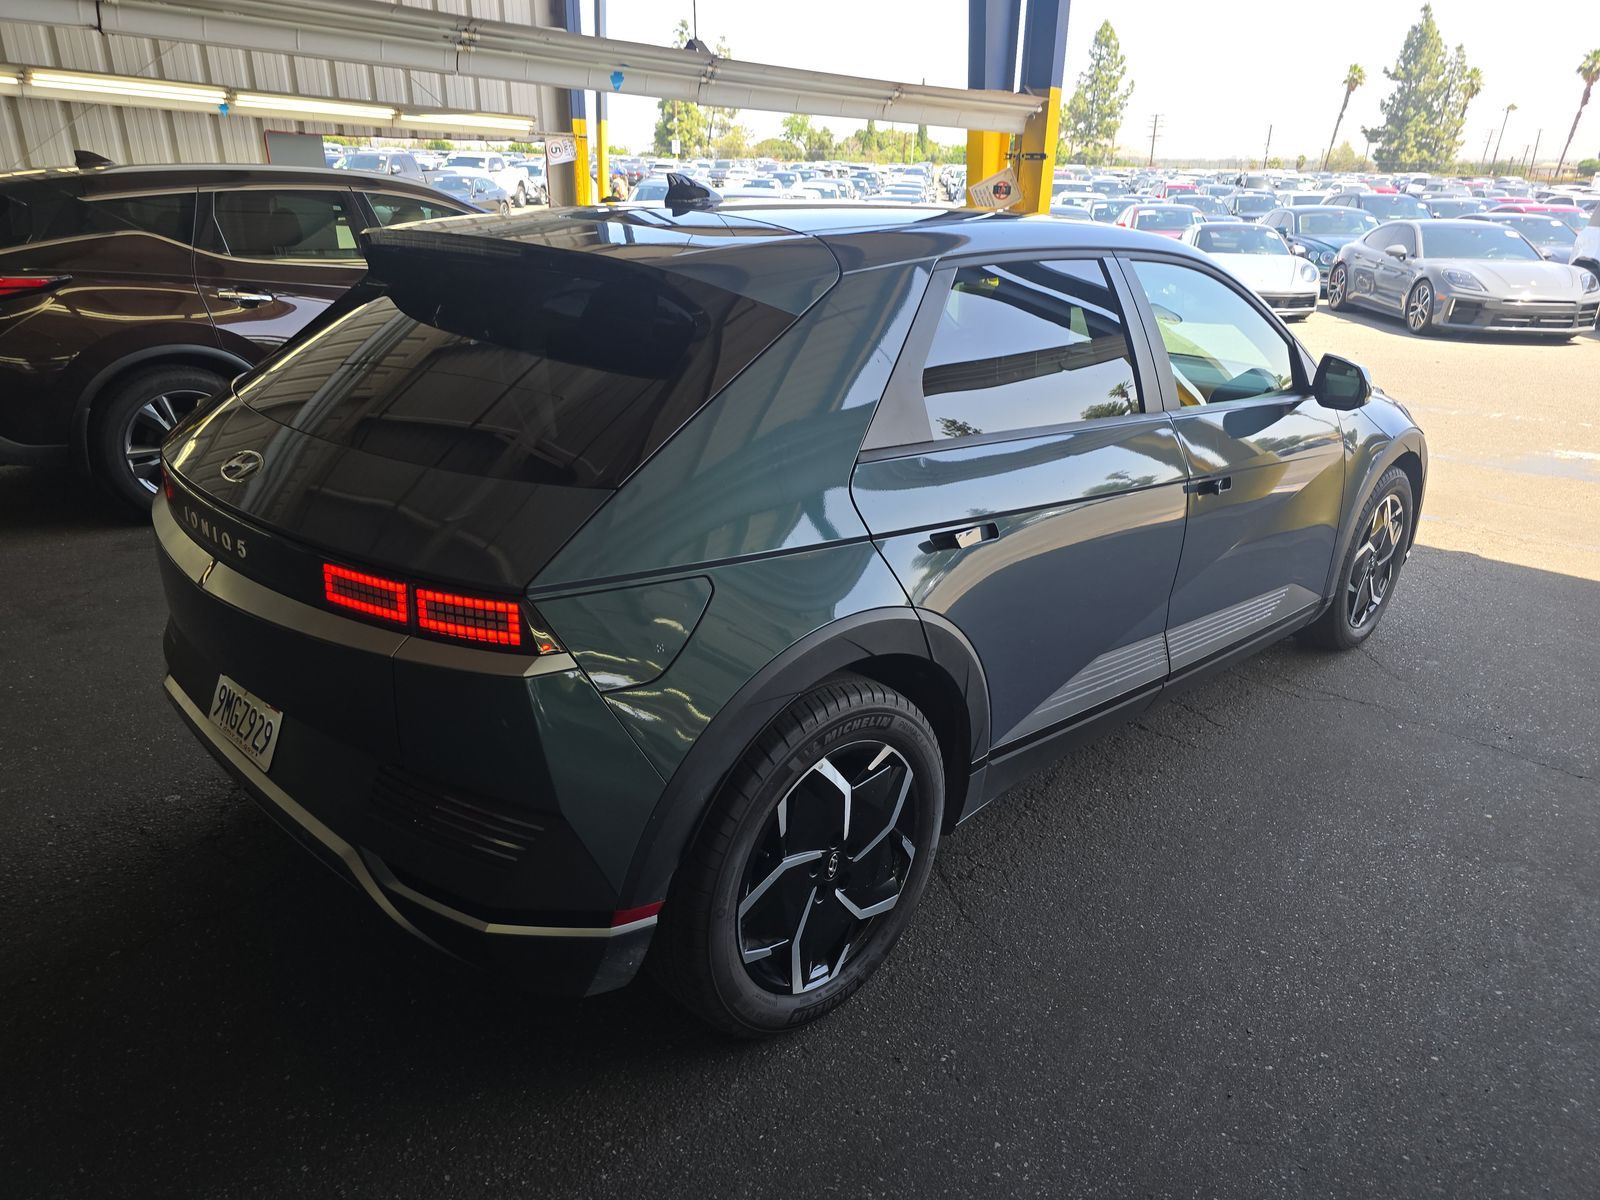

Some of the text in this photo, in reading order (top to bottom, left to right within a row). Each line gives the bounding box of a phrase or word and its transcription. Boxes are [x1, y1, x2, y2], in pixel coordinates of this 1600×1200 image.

[551, 146, 561, 154] 5
[213, 684, 273, 754] 9MGZ929
[824, 716, 891, 745] MICHELIN
